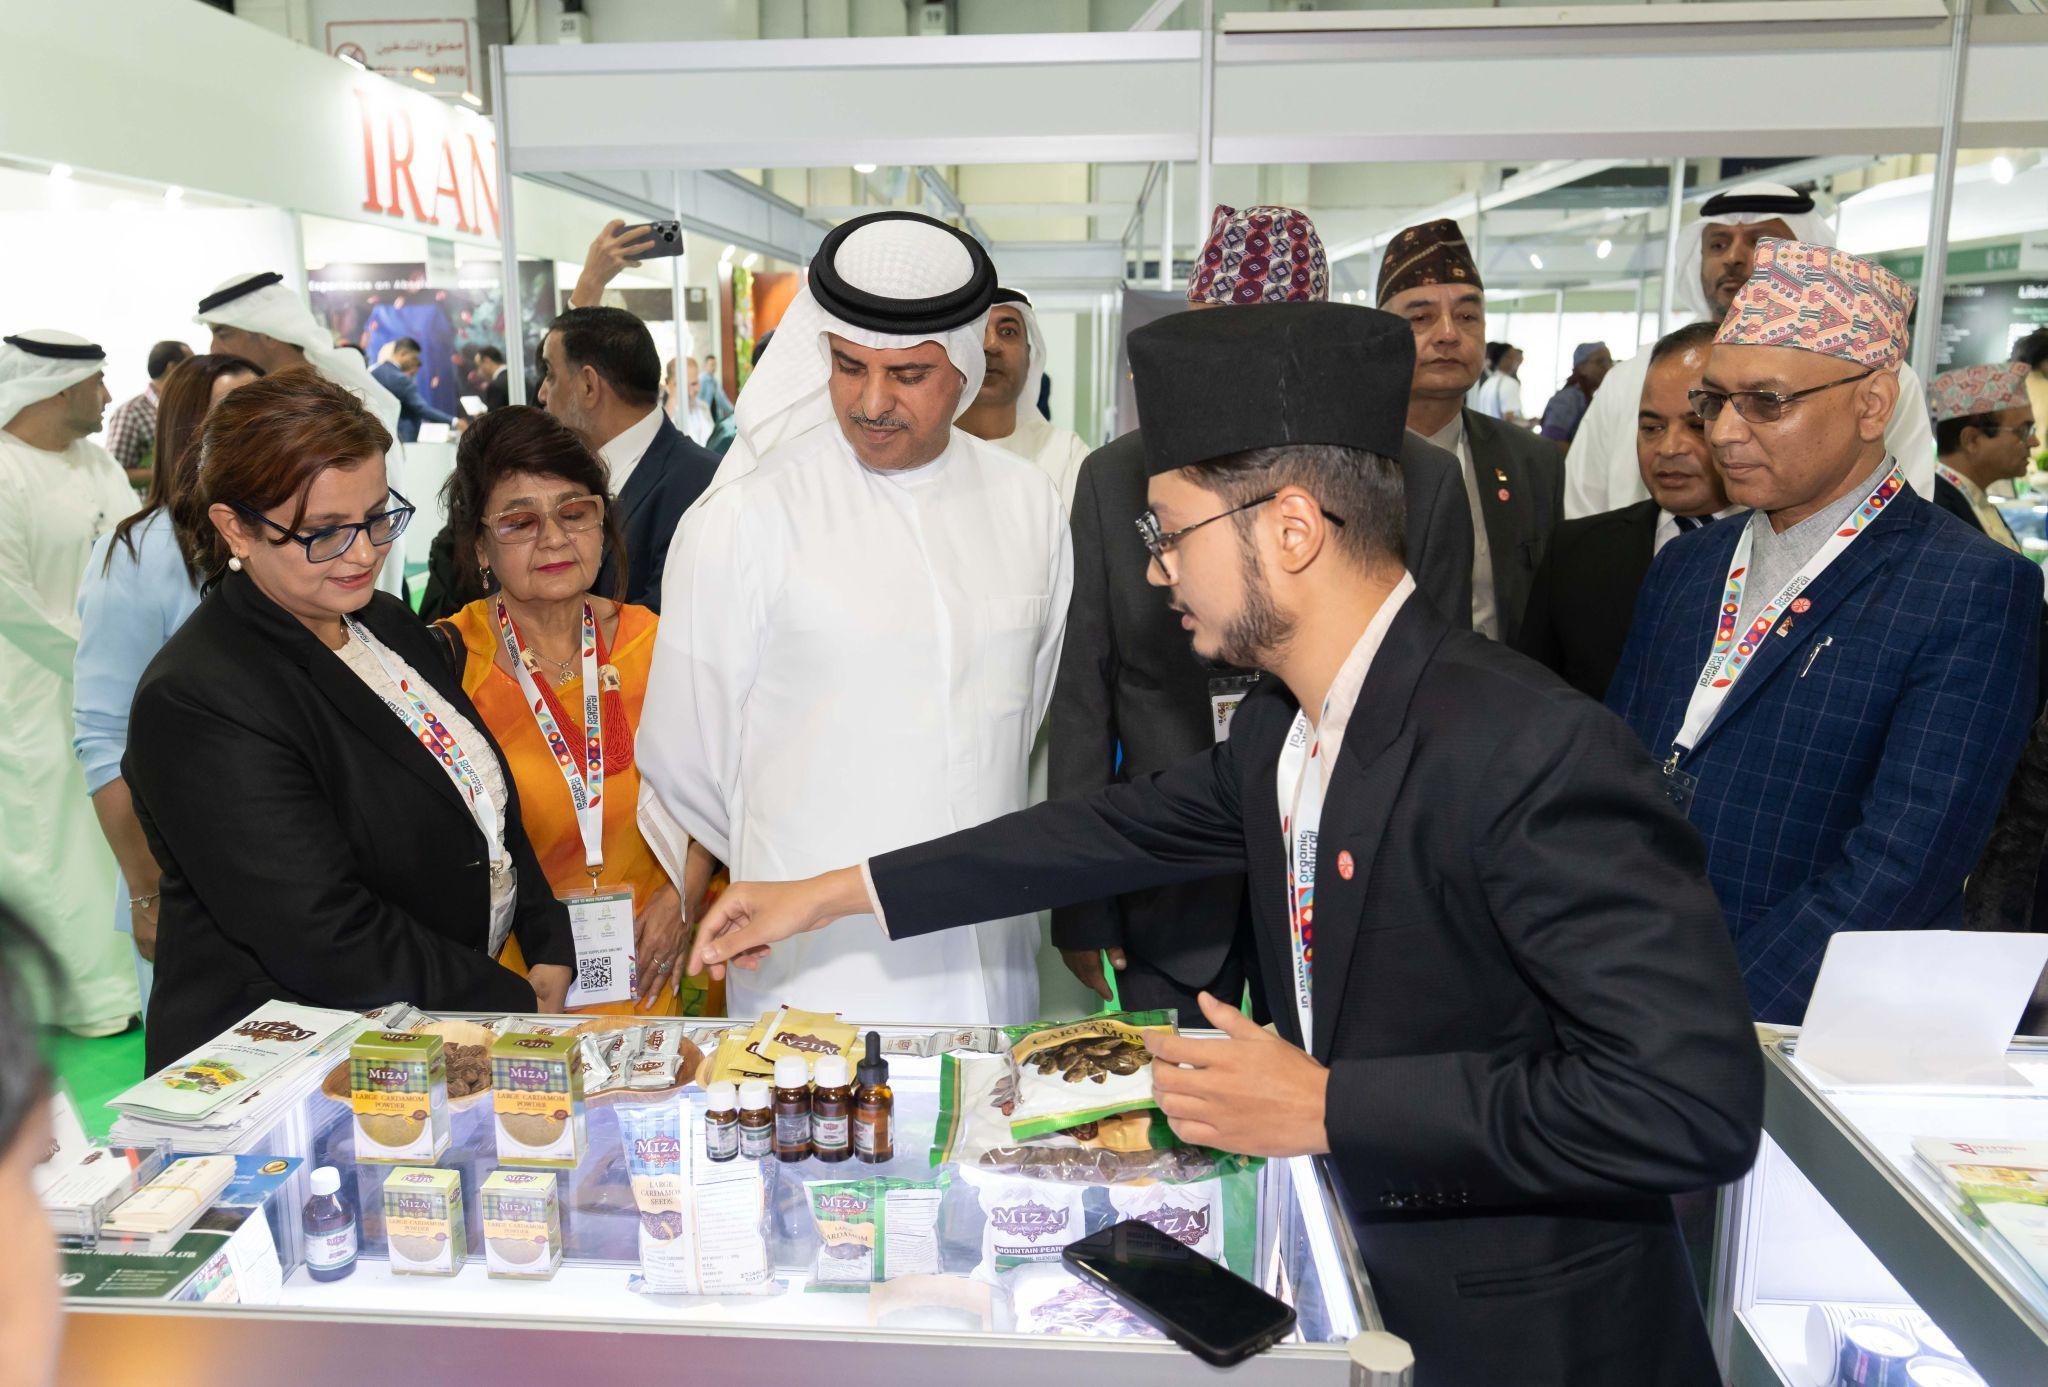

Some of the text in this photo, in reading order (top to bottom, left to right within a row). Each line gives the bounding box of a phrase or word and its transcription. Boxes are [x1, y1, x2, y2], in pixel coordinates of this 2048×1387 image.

[353, 87, 500, 240] IRAN
[1298, 830, 1310, 883] Organic
[242, 1021, 315, 1040] MIZAJ
[383, 1033, 420, 1041] MIZAJ
[516, 1040, 552, 1048] MIZAJ
[777, 1034, 839, 1056] MIZAJ
[368, 1068, 409, 1081] MIZAJ
[510, 1067, 549, 1080] MIZAJ
[380, 1094, 424, 1102] CARDAMOM
[522, 1094, 565, 1102] CARDAMOM
[375, 1101, 405, 1109] POWDER
[635, 1140, 680, 1154] MIZA
[649, 1181, 673, 1189] LARGE
[399, 1199, 431, 1209] MIZAJ
[498, 1202, 531, 1213] MIZAJ
[650, 1198, 673, 1206] SEEDS
[820, 1195, 867, 1210] MIZAJ
[996, 1208, 1067, 1227] MIZAJ
[1154, 1209, 1210, 1235] IZAJ
[827, 1231, 868, 1241] ARDAMOM
[997, 1246, 1039, 1255] MOUNTAIN
